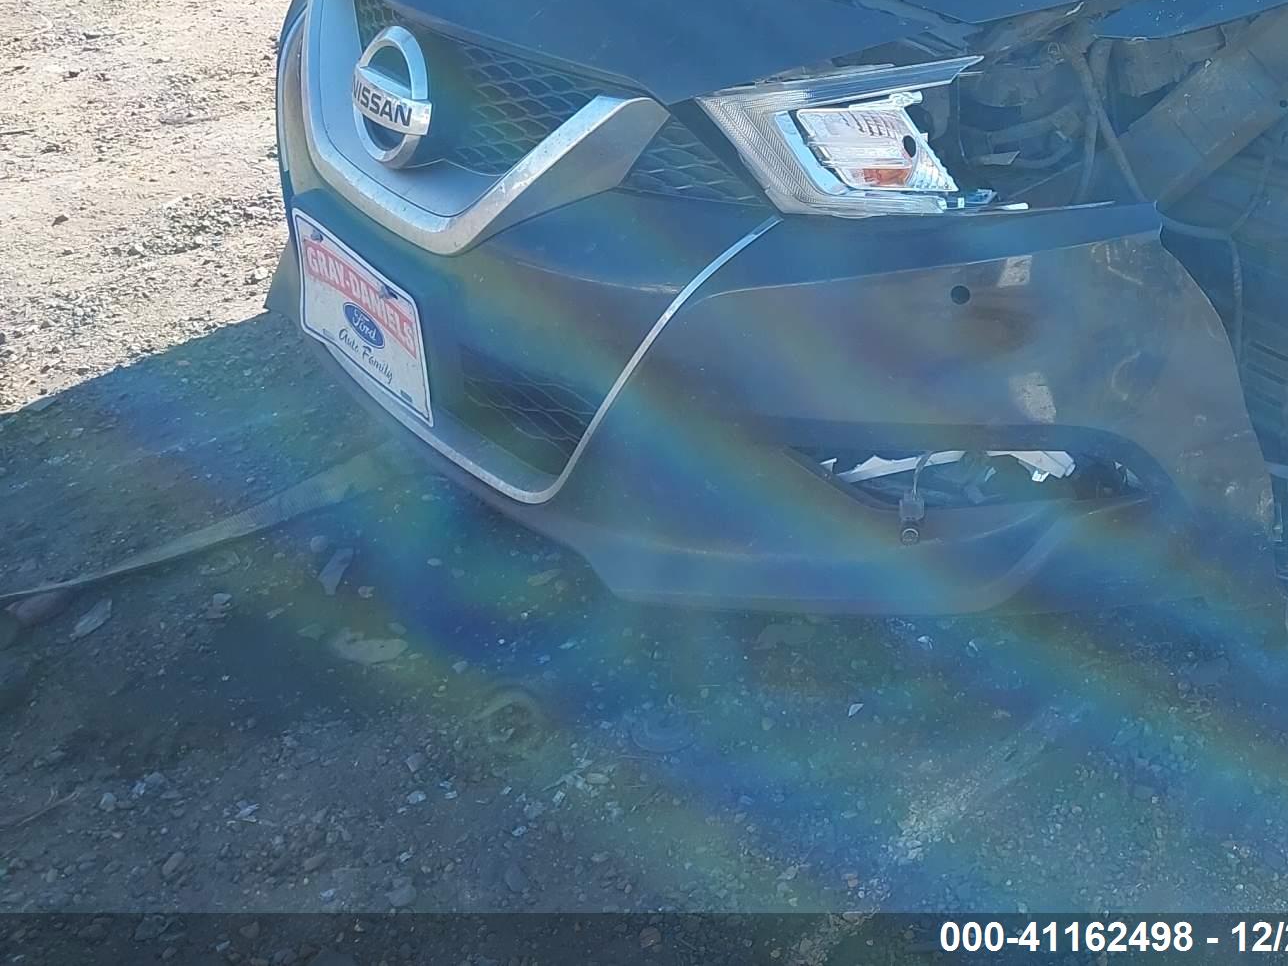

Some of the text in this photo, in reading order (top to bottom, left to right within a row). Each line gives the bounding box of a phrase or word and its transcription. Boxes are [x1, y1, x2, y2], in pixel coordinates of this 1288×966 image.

[353, 75, 412, 127] NISSAN
[352, 309, 377, 341] Ford
[362, 345, 393, 385] Family
